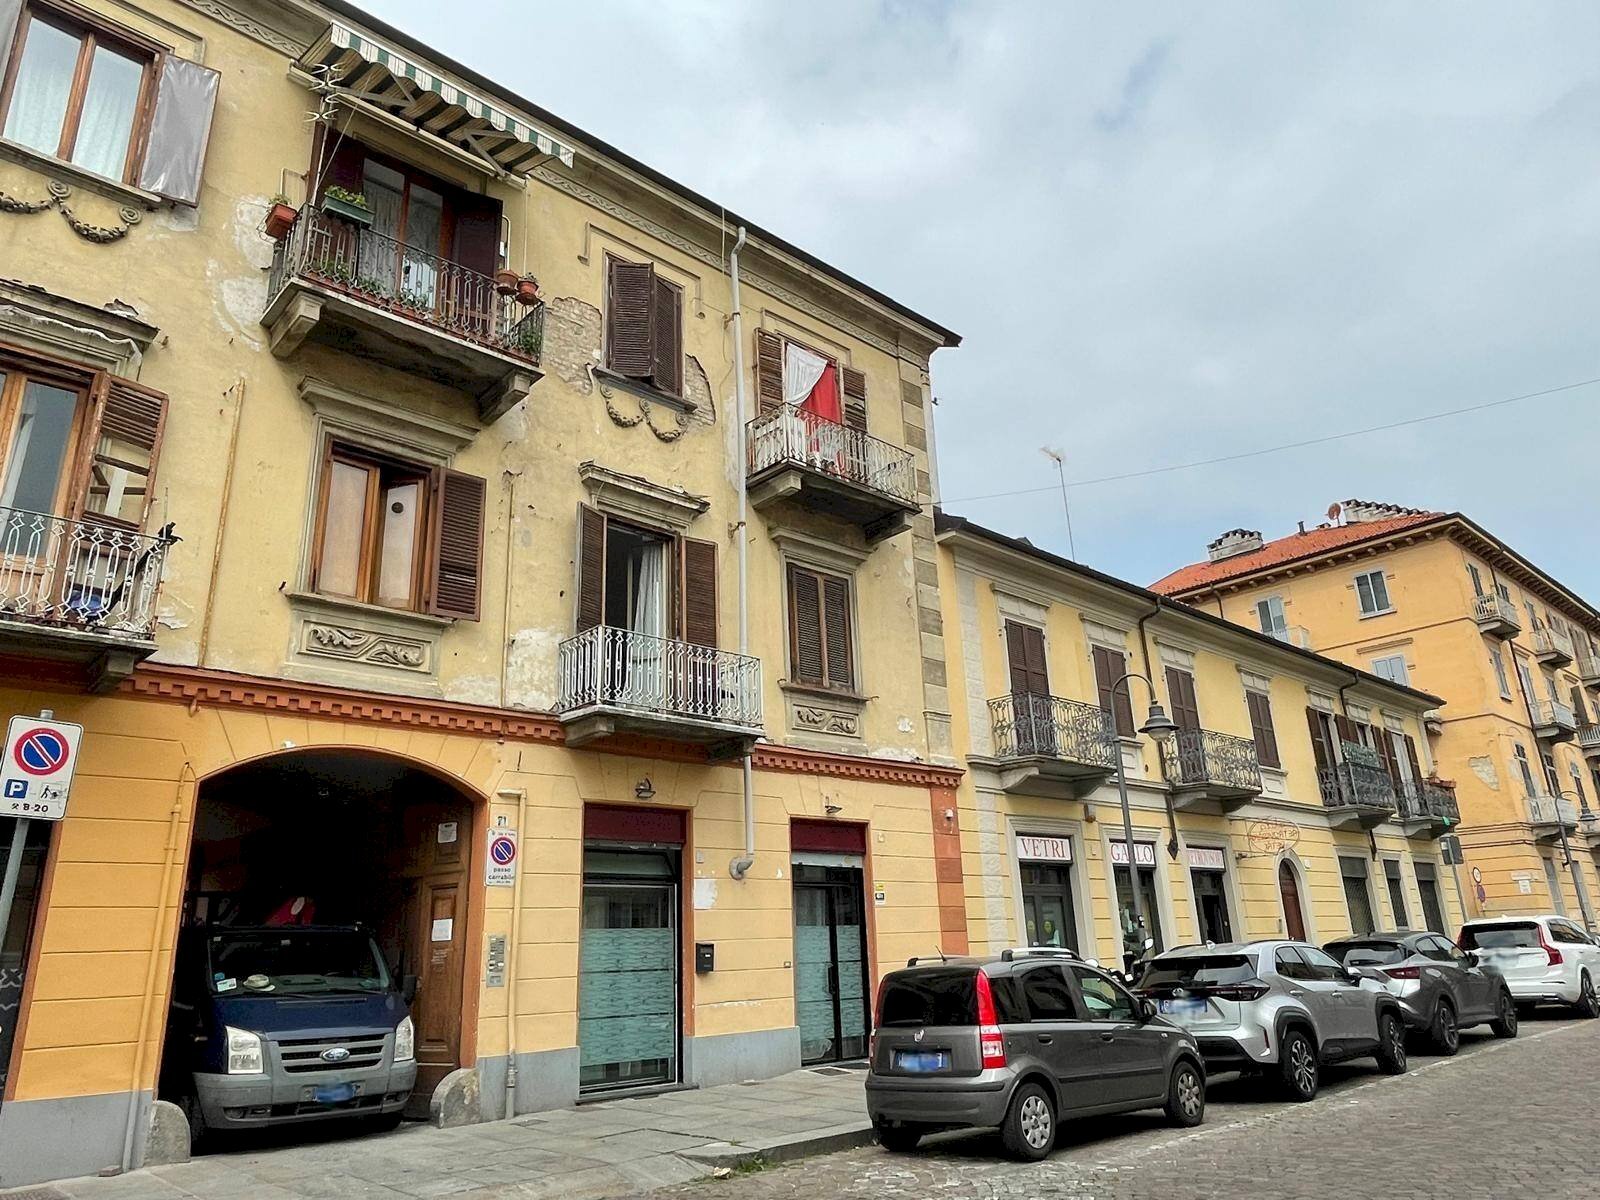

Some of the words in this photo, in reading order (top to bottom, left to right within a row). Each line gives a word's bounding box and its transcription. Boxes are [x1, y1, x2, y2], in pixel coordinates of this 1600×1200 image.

[23, 803, 49, 812] 8-20
[1021, 837, 1066, 858] VETRI
[1110, 843, 1153, 862] GALO
